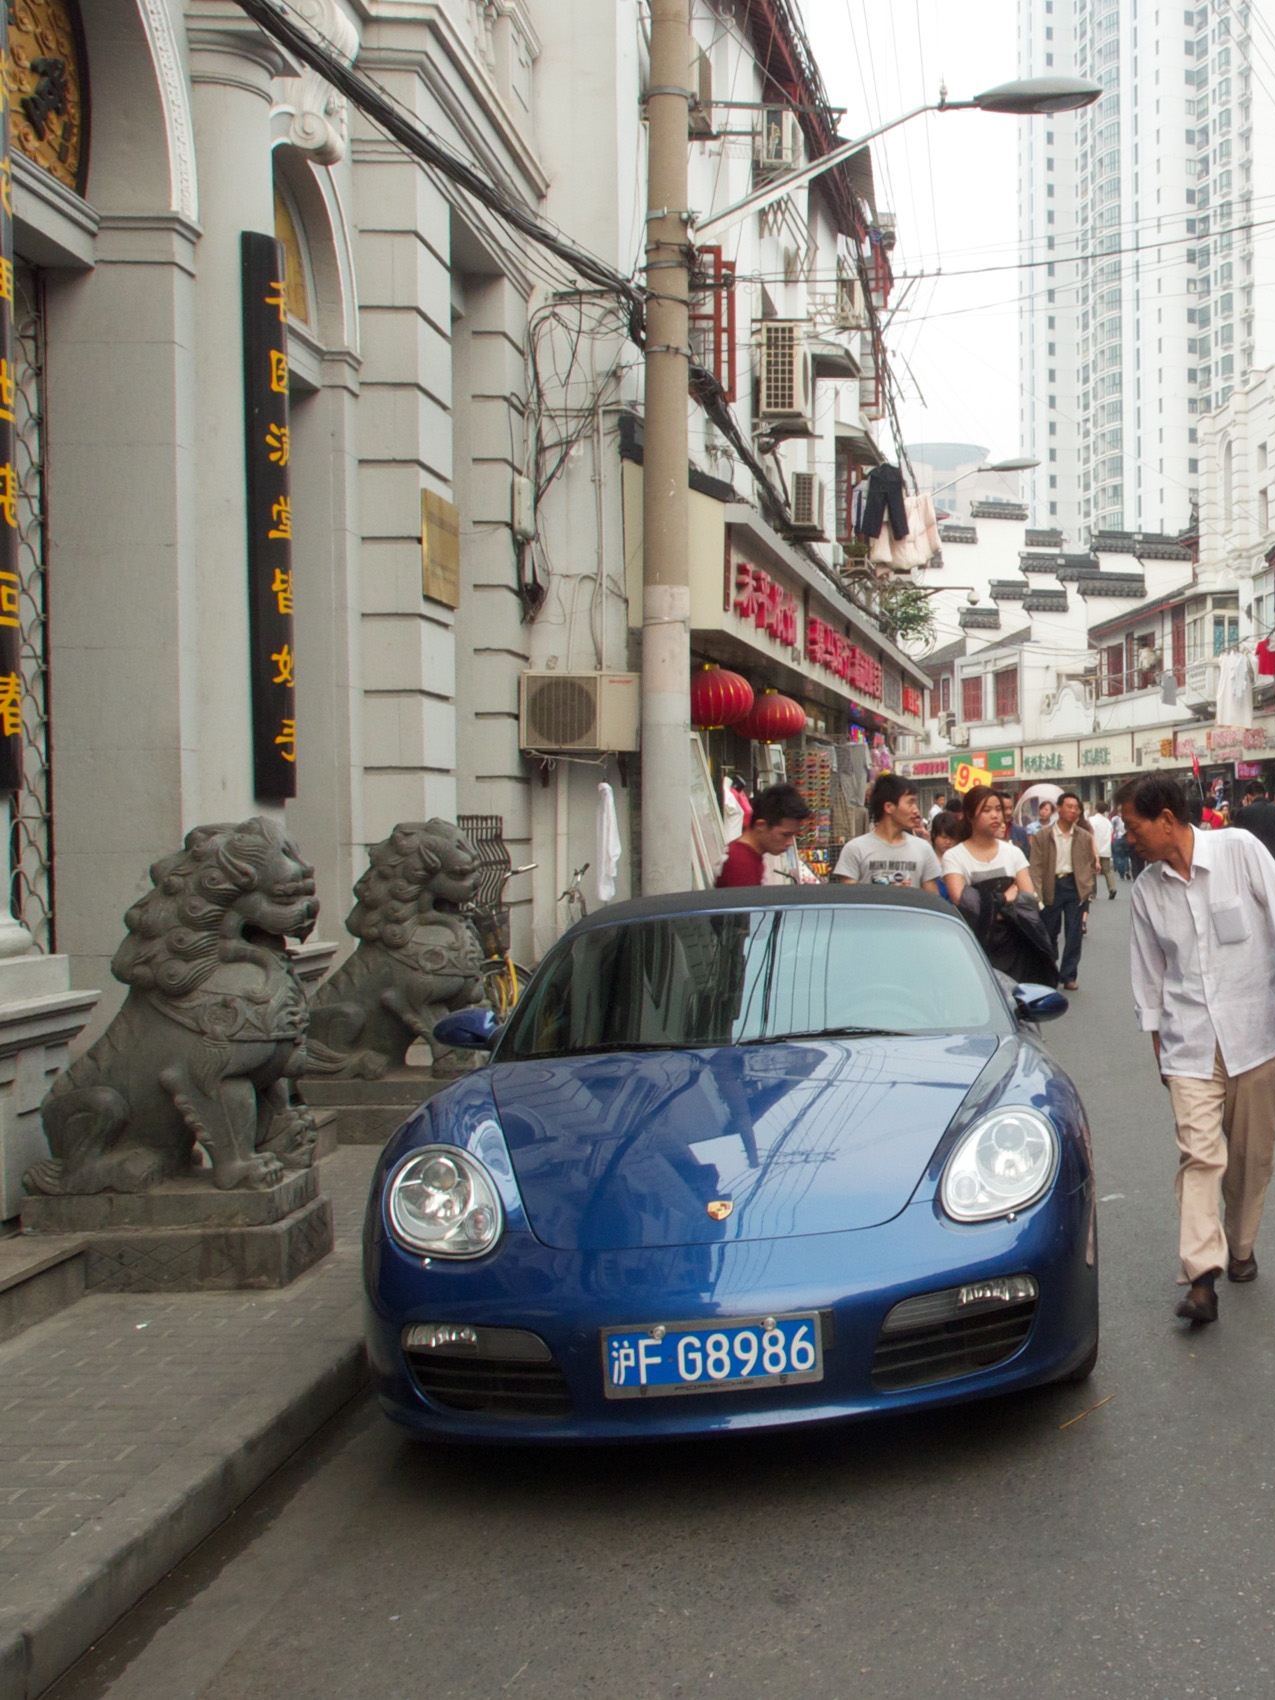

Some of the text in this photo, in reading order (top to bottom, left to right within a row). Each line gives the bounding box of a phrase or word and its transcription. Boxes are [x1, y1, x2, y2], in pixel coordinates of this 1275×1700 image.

[869, 860, 886, 871] MINI
[611, 1325, 816, 1385] 沪F G8986
